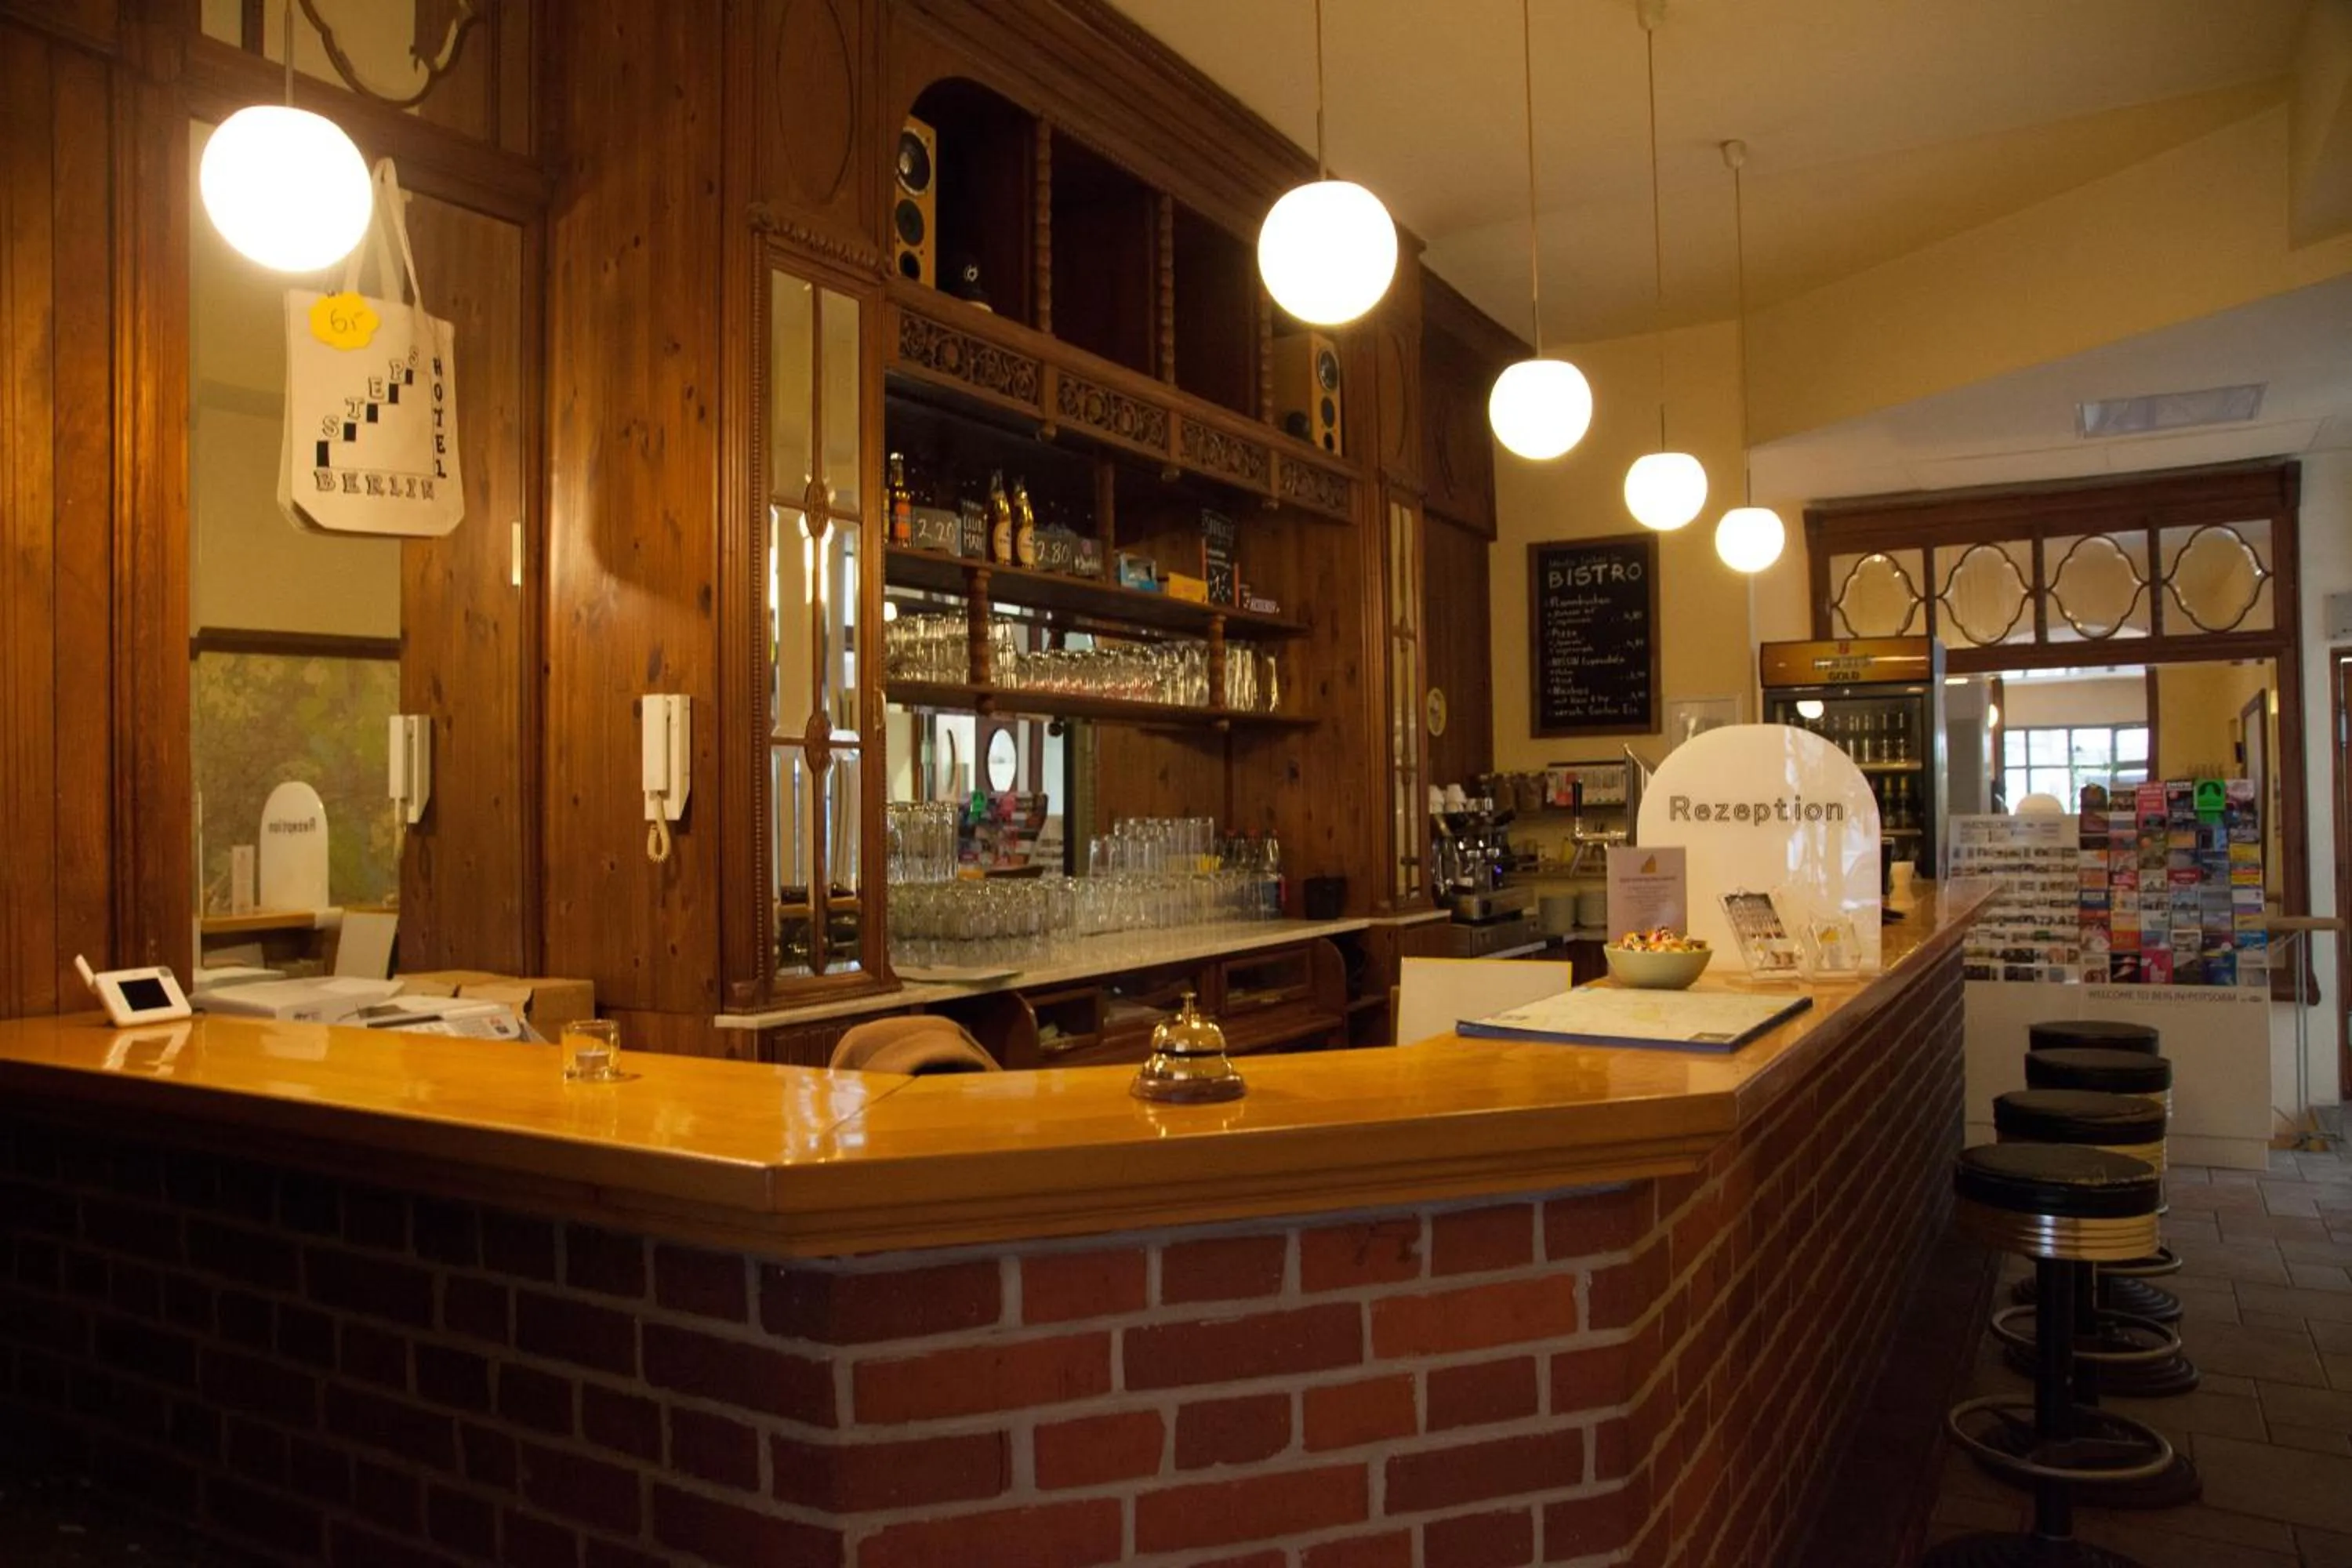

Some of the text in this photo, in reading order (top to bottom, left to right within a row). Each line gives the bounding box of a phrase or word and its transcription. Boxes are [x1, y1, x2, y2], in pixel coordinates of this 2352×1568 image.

[433, 357, 447, 479] HOTEL
[314, 470, 434, 501] BERLIN
[1548, 561, 1642, 590] BISTRO
[1669, 795, 1844, 825] Rezeption
